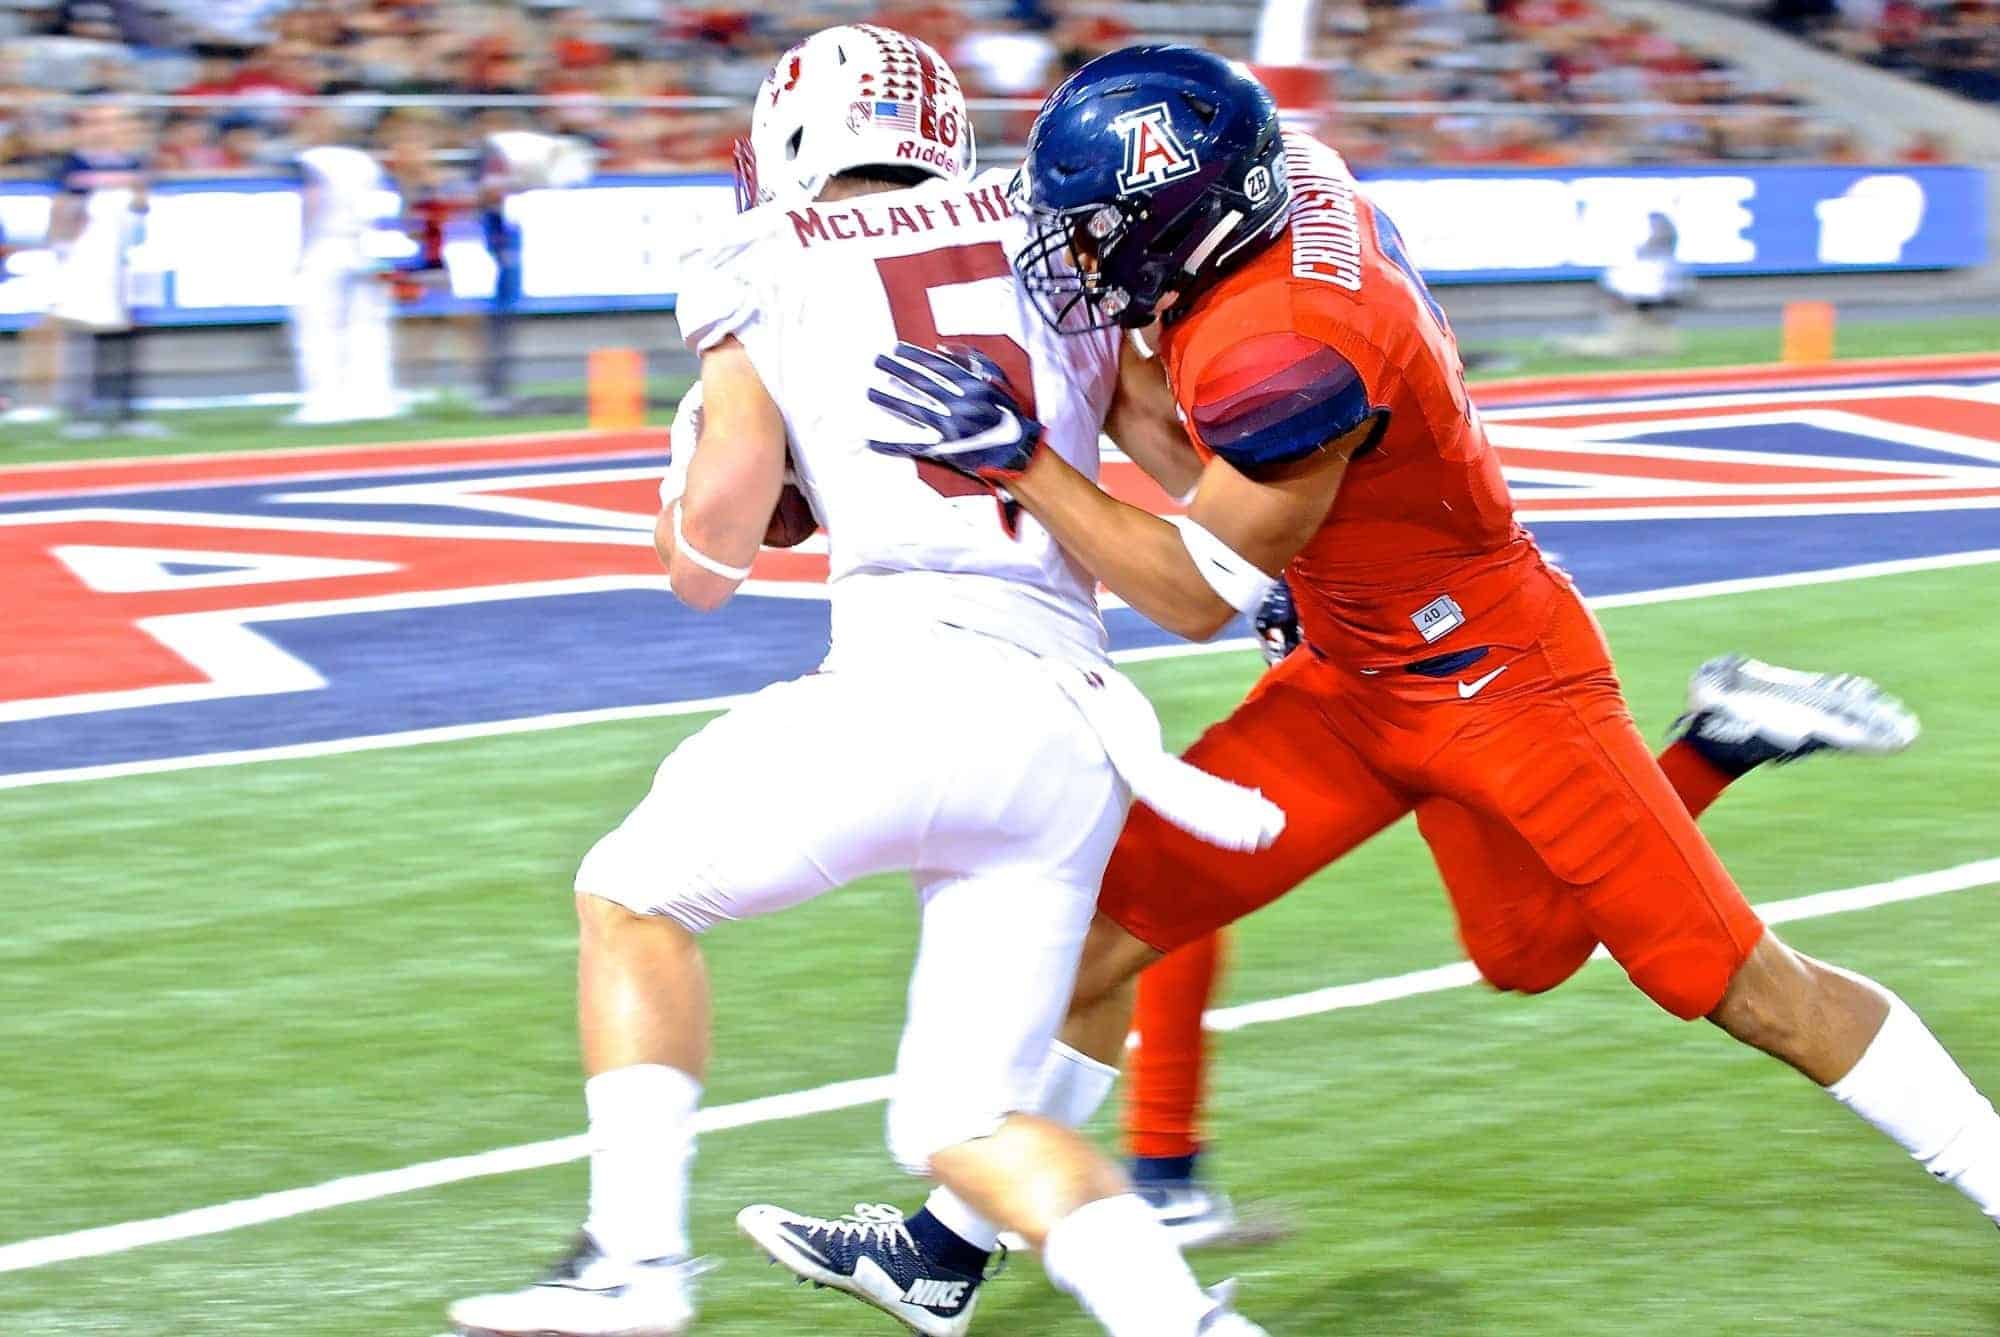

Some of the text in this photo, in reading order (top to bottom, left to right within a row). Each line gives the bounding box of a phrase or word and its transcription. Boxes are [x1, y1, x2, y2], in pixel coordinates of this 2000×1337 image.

[1105, 102, 1200, 195] A
[1248, 170, 1266, 197] ZH
[874, 241, 1036, 498] 5
[1424, 608, 1440, 622] 40
[901, 1278, 969, 1308] NIKE
